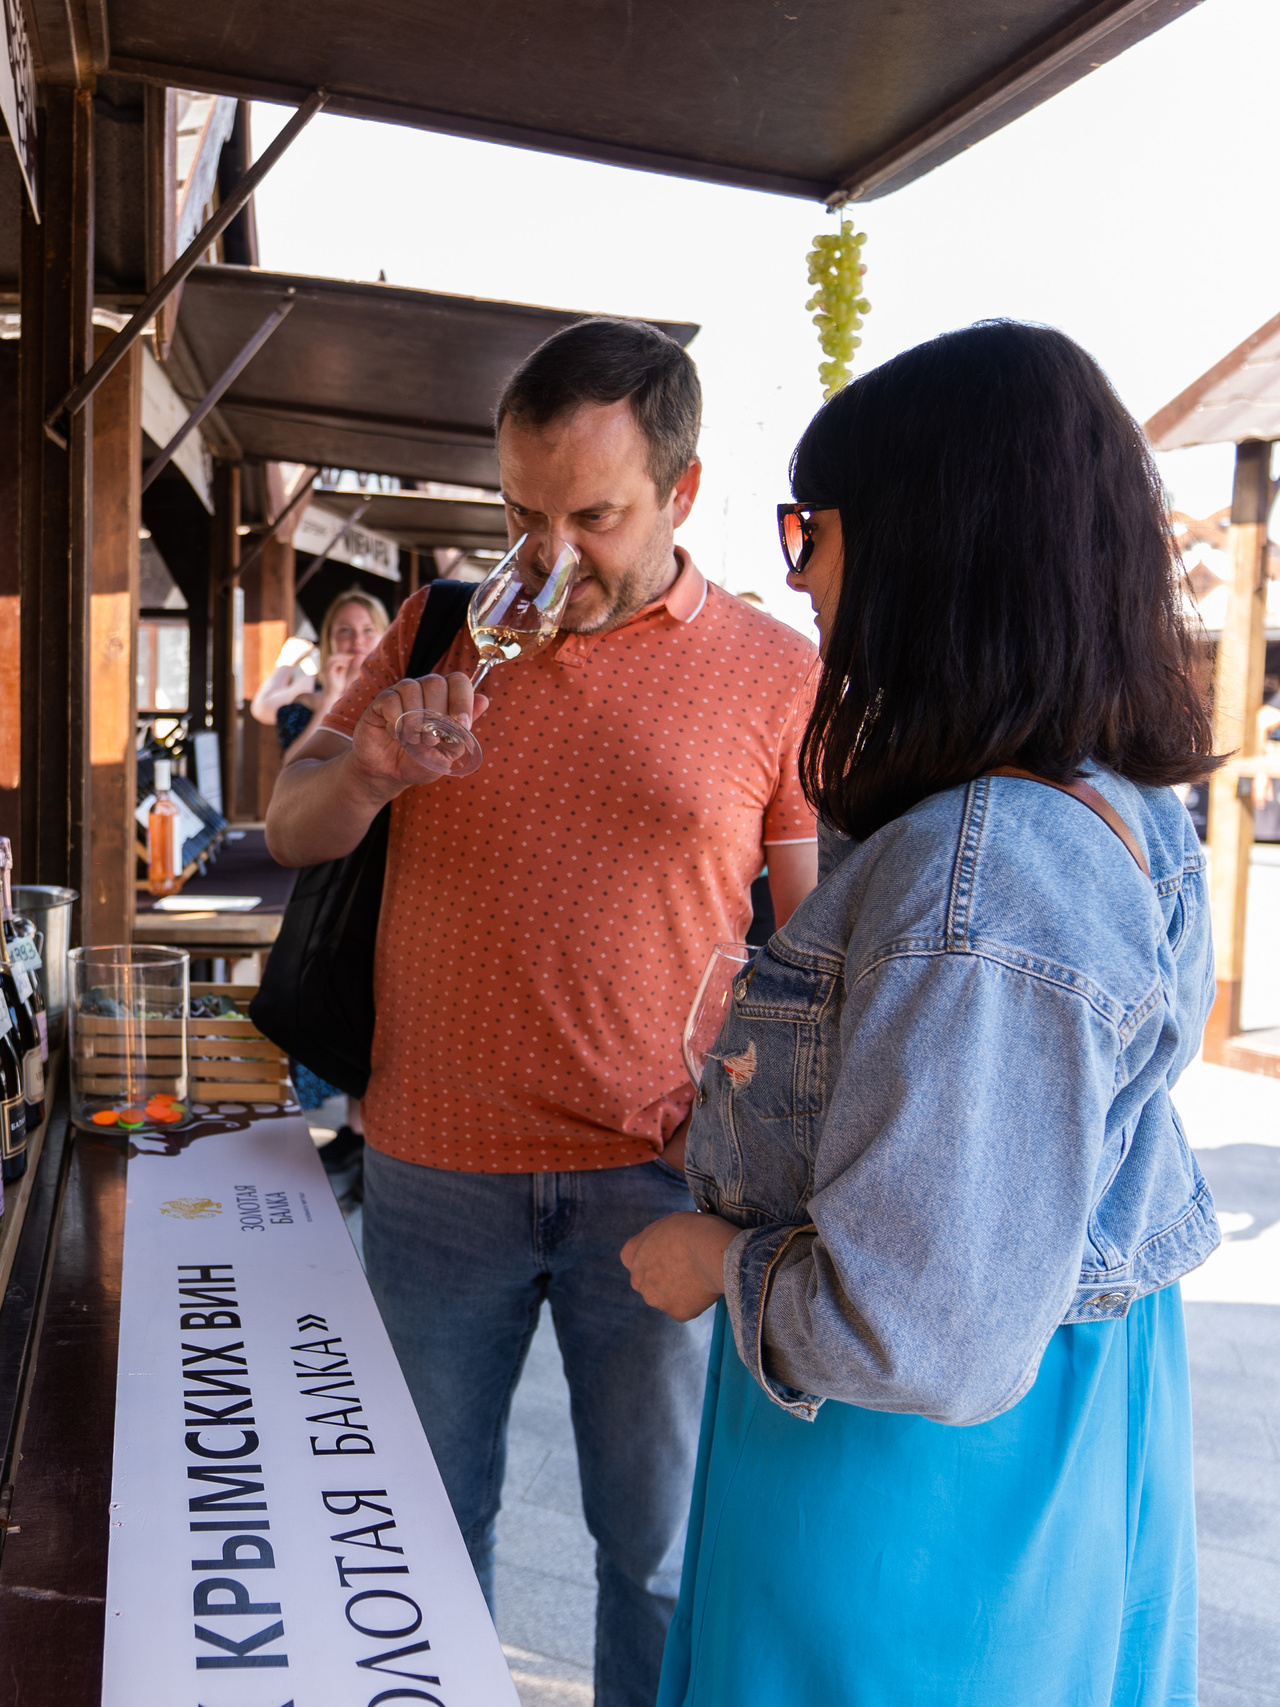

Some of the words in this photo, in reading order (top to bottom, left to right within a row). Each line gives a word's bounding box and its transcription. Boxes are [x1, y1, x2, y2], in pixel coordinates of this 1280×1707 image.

[234, 1184, 267, 1233] ЗОЛОТАЯ
[265, 1190, 295, 1225] БАЛКА
[176, 1263, 243, 1331] ВИН
[289, 1312, 376, 1456] БАЛКА»
[180, 1340, 290, 1671] КРЫМСКИХ
